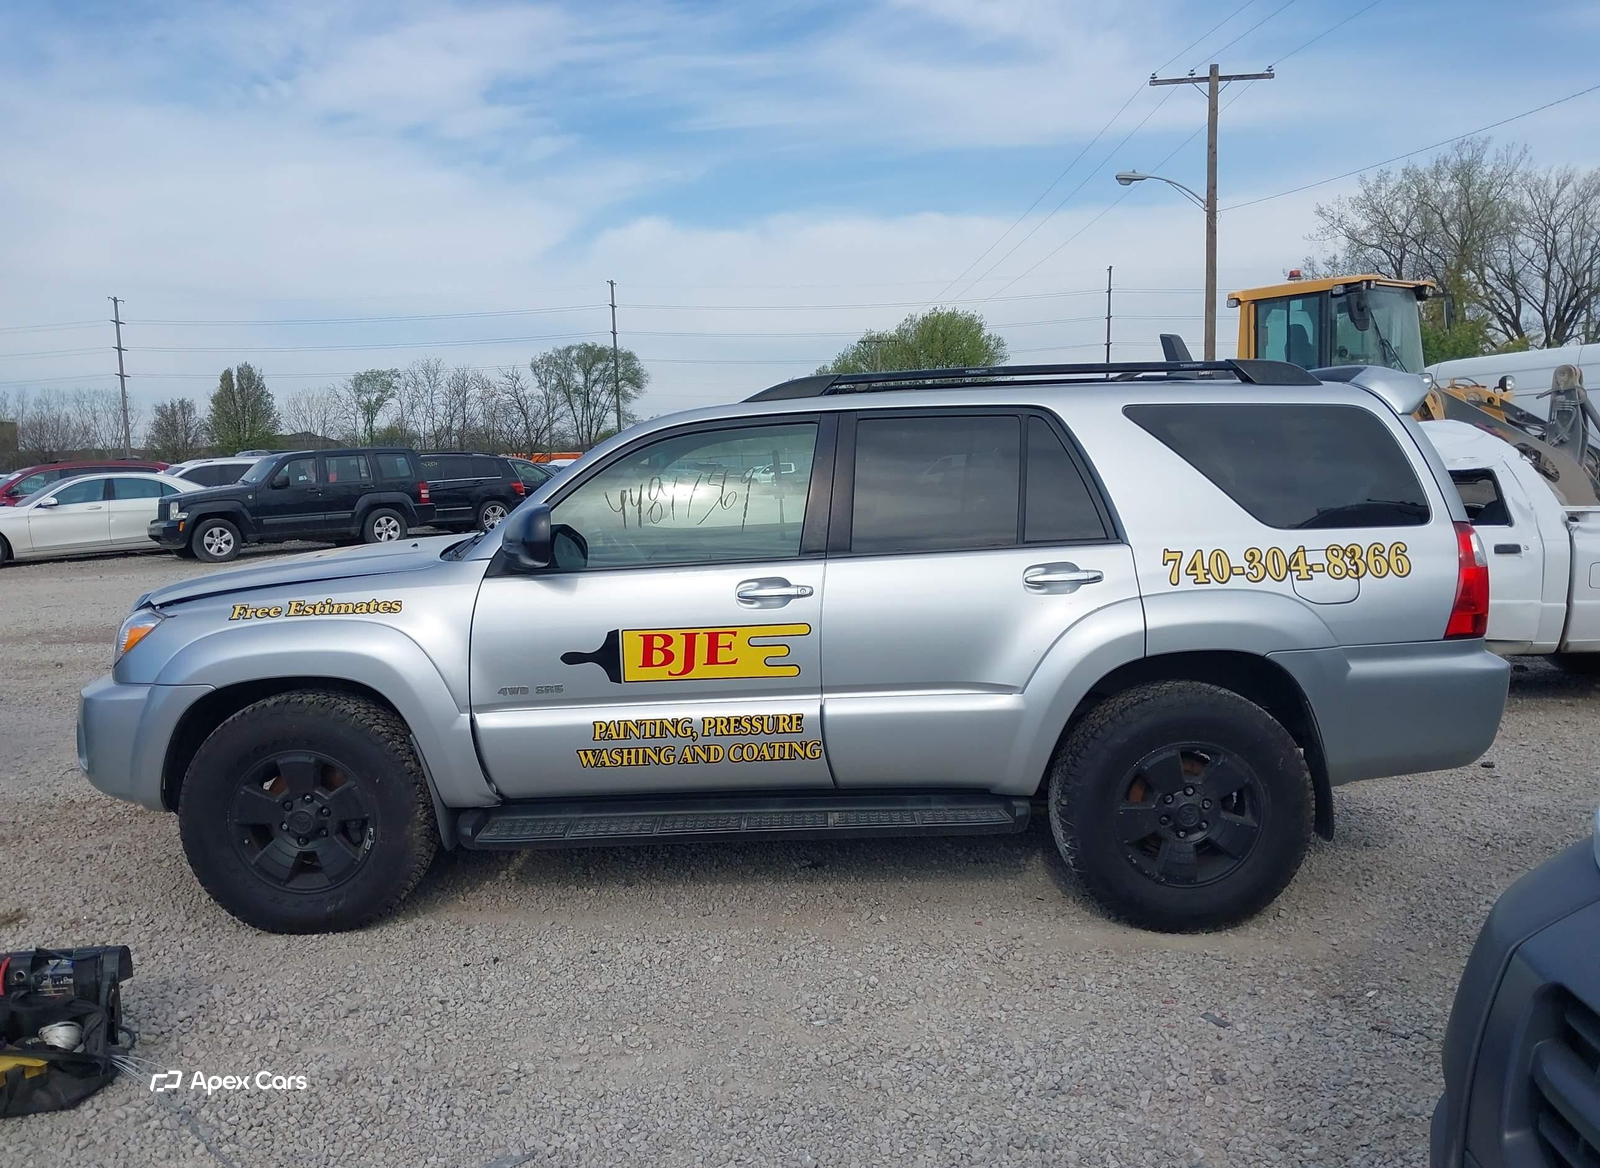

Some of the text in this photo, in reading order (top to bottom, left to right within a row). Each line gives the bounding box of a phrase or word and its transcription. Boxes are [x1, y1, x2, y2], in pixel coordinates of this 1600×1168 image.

[1162, 541, 1412, 586] 740-304-8366
[229, 598, 403, 621] Free Estimates
[637, 630, 739, 677] BJE
[497, 686, 530, 696] 4WD
[592, 713, 804, 742] PAINTING, PRESSURE
[576, 739, 822, 769] WASHING AND COATING
